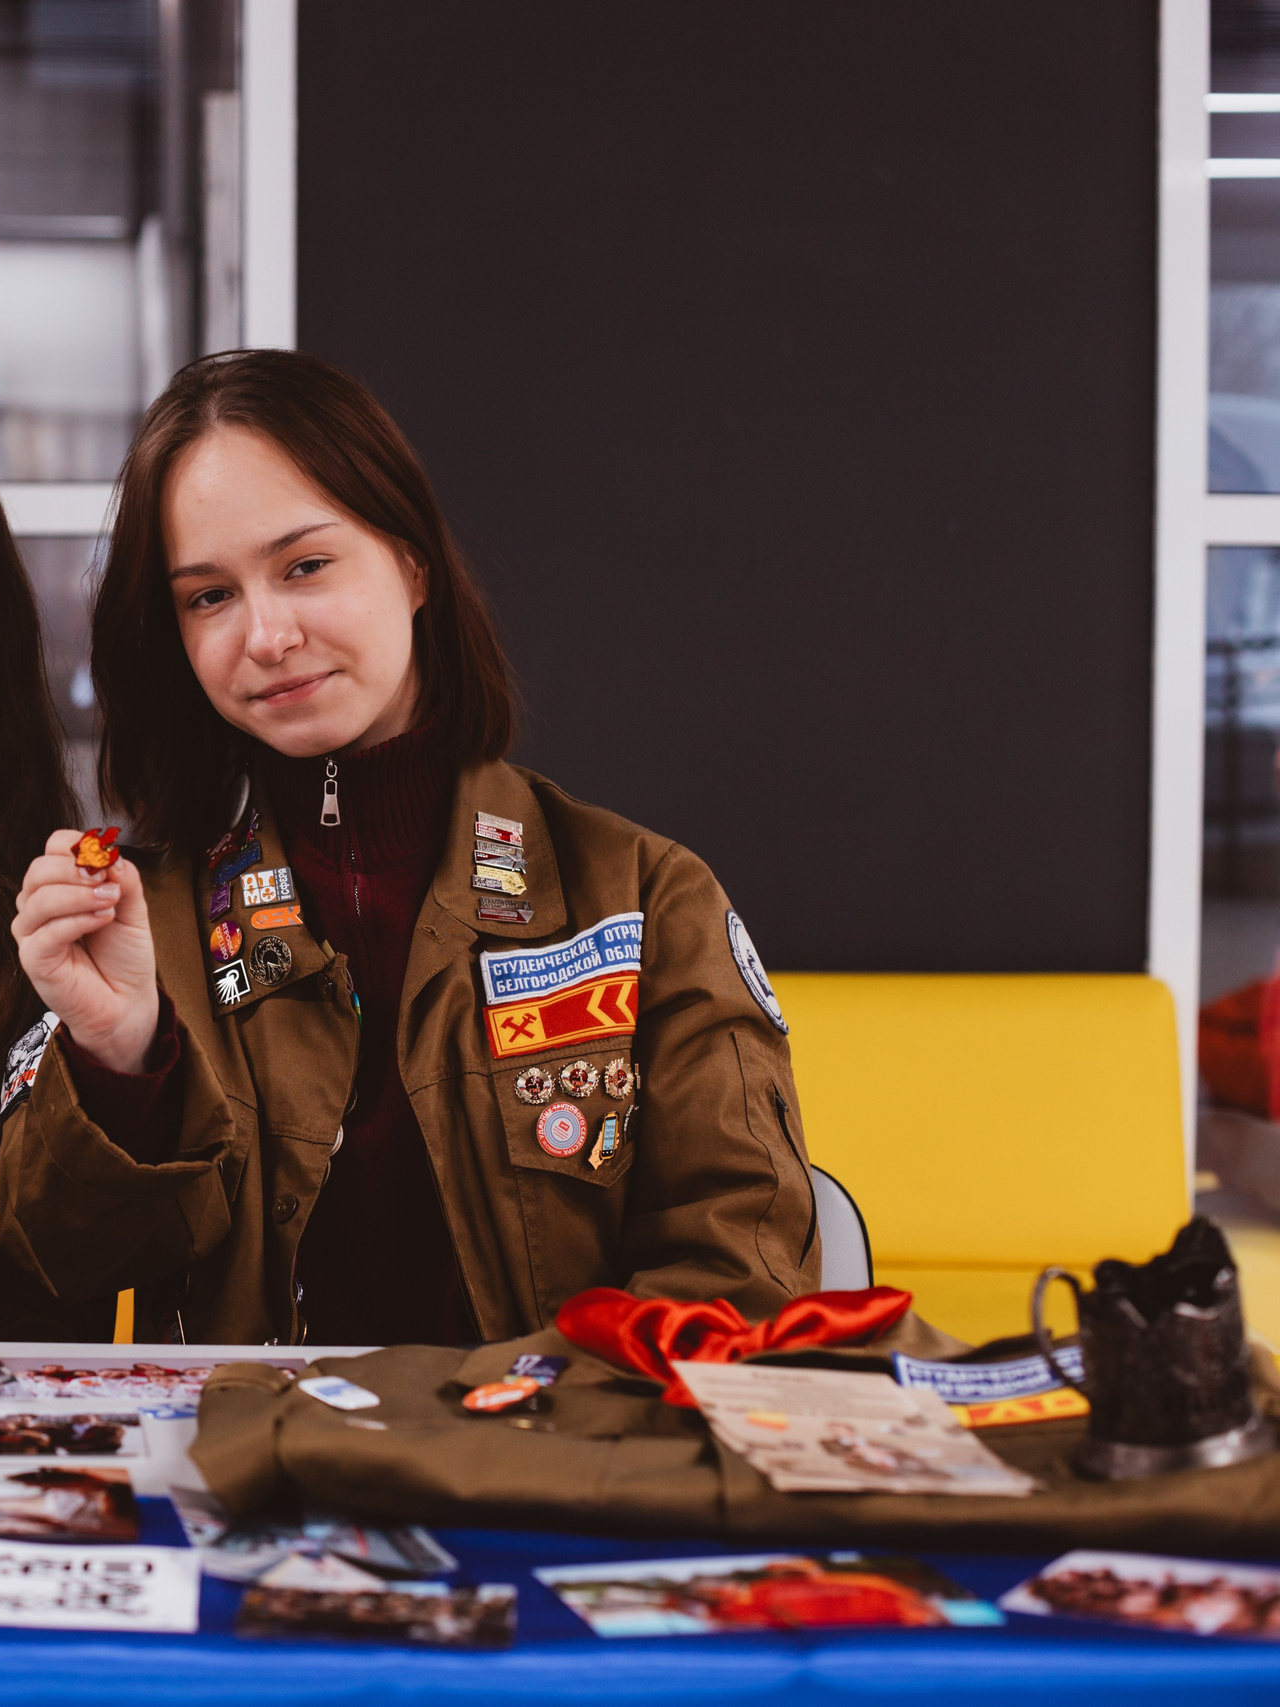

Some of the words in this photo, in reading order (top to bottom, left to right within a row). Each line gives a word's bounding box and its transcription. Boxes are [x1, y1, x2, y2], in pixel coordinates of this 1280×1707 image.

[493, 937, 596, 976] СТУДЕНЧЕСКИЕ
[497, 950, 602, 993] БЕЛГОРОДСКОЙ
[563, 1126, 586, 1156] СЕМЕСТРА
